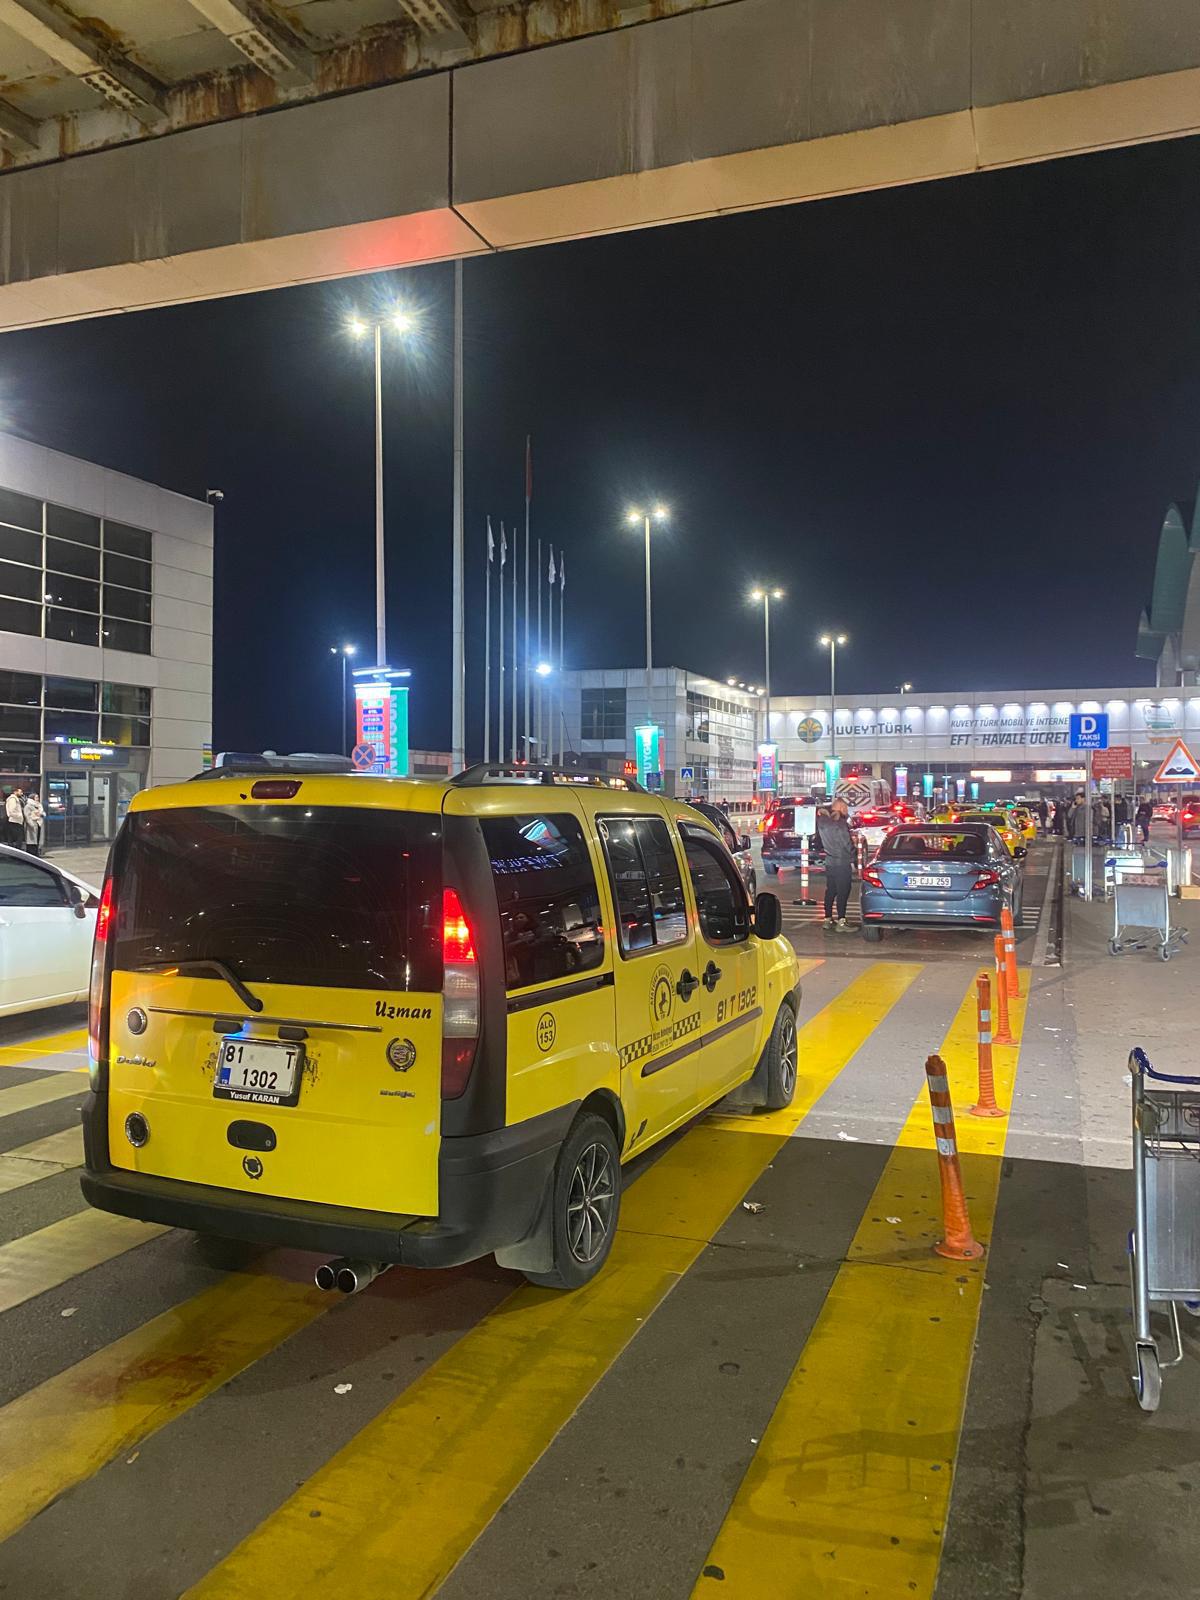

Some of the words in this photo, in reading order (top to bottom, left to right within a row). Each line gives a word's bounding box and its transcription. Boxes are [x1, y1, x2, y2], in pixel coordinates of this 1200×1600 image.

[951, 719, 978, 728] KUVEYT
[980, 717, 999, 727] TÜRK
[1001, 717, 1023, 727] MOBİL
[1026, 718, 1034, 726] VE
[1036, 716, 1069, 726] İNTERNE
[1081, 716, 1097, 734] D
[950, 734, 971, 746] EFT
[982, 732, 1026, 745] HAVALE
[1077, 733, 1100, 741] TAKSİ
[908, 877, 917, 885] 35
[936, 877, 950, 886] 259
[375, 1000, 432, 1019] Uzman
[717, 998, 727, 1023] 81
[730, 995, 736, 1017] T
[738, 985, 757, 1012] 1302
[540, 1019, 553, 1030] ALO
[540, 1030, 553, 1044] 153
[226, 1045, 244, 1064] 81
[286, 1051, 296, 1070] T
[242, 1068, 278, 1090] 1302
[230, 1091, 251, 1101] Yusuf
[252, 1093, 280, 1104] KARAN
